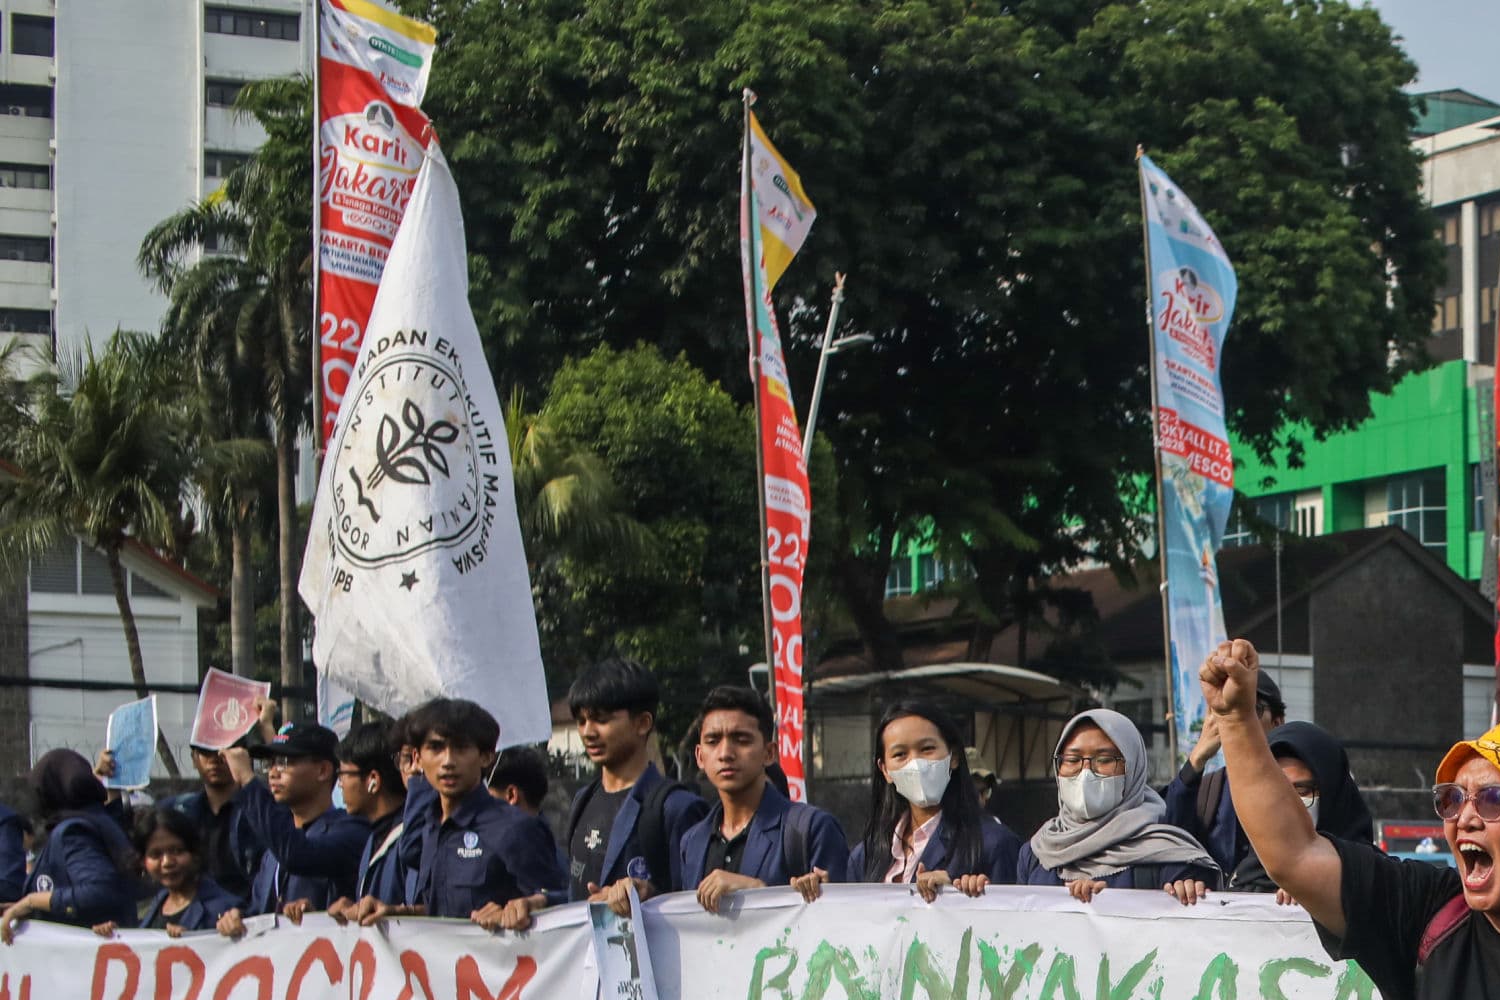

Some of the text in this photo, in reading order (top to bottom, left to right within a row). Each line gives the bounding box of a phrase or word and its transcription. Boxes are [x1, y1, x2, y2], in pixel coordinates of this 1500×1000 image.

[358, 328, 428, 380] BADAN
[344, 365, 460, 451] INSTITUT
[335, 482, 370, 551] BOGOR
